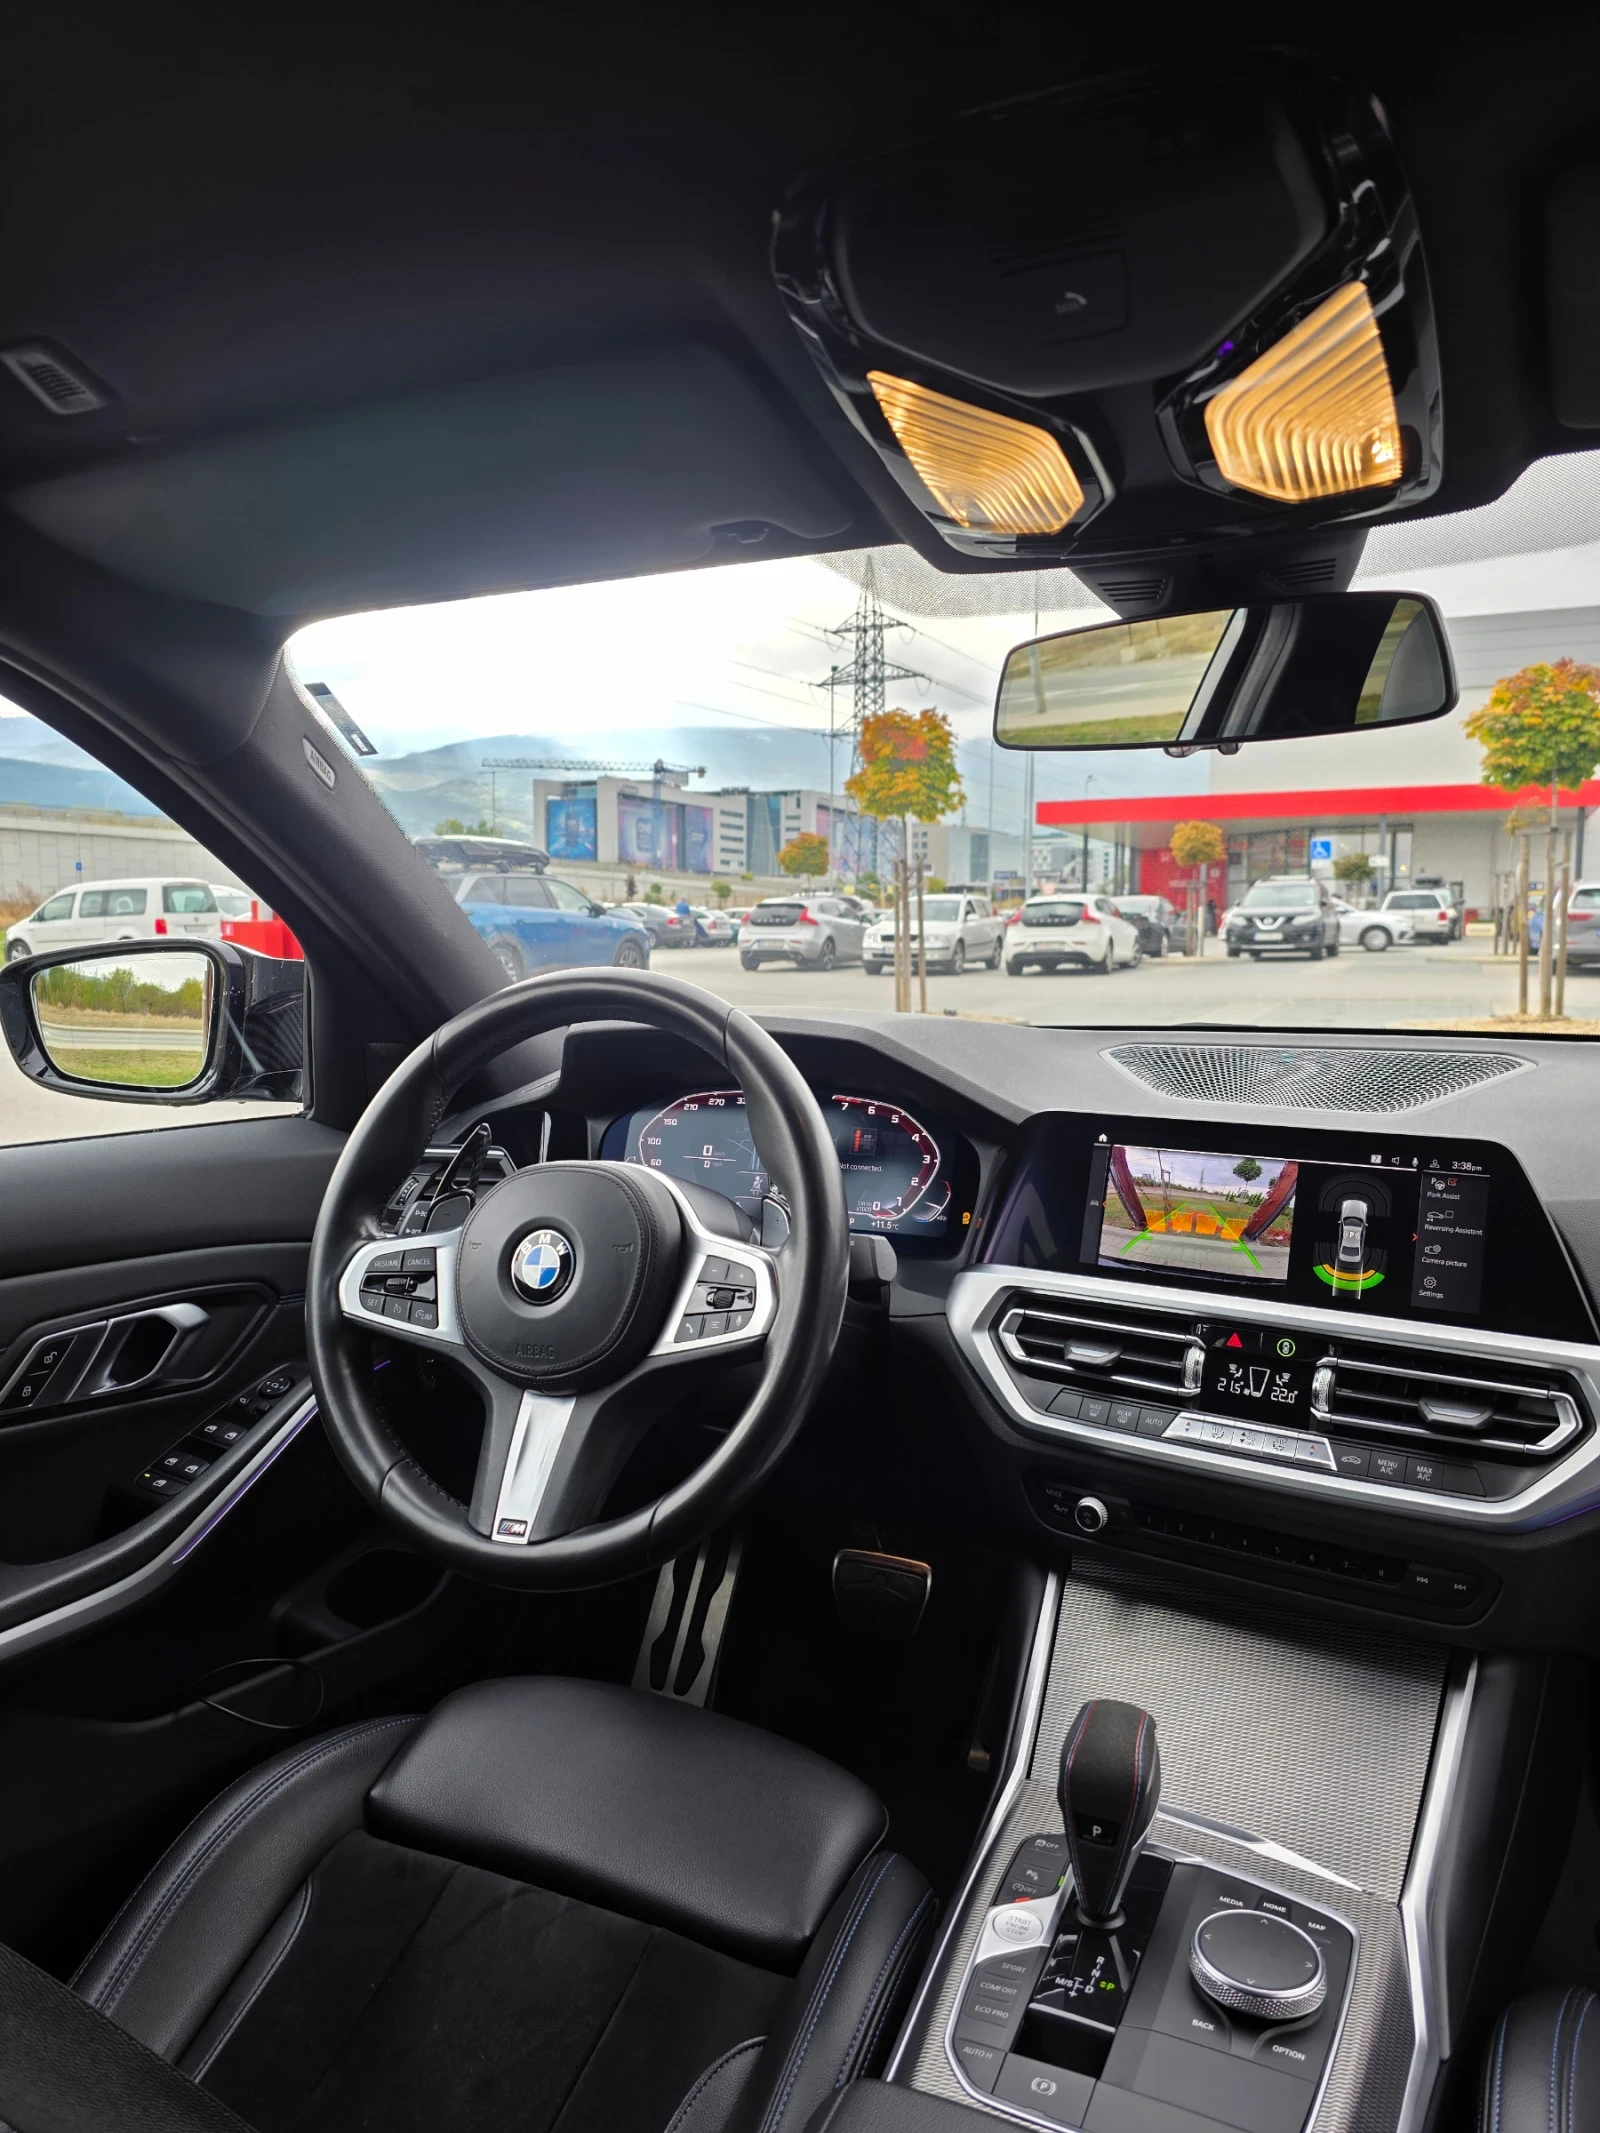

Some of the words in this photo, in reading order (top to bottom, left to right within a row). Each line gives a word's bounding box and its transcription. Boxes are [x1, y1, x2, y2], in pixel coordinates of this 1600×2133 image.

[684, 1103, 698, 1111] 210
[708, 1098, 725, 1106] 270
[841, 1102, 849, 1111] 7
[868, 1106, 876, 1115] 6
[891, 1115, 899, 1123] 5
[647, 1137, 661, 1145] 100
[911, 1133, 920, 1142] 4
[703, 1145, 713, 1156] 0
[703, 1160, 711, 1168] 0
[922, 1155, 931, 1164] 3
[1452, 1160, 1483, 1172] 3:38pm
[911, 1177, 919, 1186] 2
[1427, 1191, 1442, 1199] Park
[1442, 1192, 1461, 1200] Assist
[872, 1201, 881, 1211] 0
[896, 1196, 902, 1206] 1
[1424, 1224, 1454, 1233] Reversing
[1455, 1227, 1483, 1236] Assistant
[520, 1233, 569, 1256] BMW
[407, 1258, 431, 1266] CANCEL
[1421, 1257, 1445, 1265] Camera
[1446, 1260, 1468, 1268] picture
[1419, 1289, 1444, 1299] Settings
[366, 1299, 378, 1307] SET
[421, 1312, 433, 1321] LIM
[1117, 1409, 1133, 1417] REAR
[1145, 1417, 1163, 1426] AUTO
[1377, 1458, 1398, 1469] MENU
[1380, 1466, 1394, 1475] A/C
[1416, 1465, 1433, 1475] MAX
[1417, 1473, 1431, 1481] A/C
[1046, 1488, 1062, 1498] MODE
[1309, 1554, 1315, 1562] 6
[1378, 1569, 1384, 1577] 8
[1092, 1825, 1102, 1836] P
[1046, 1842, 1060, 1850] OFF
[1024, 1886, 1037, 1894] OFF
[1218, 1896, 1244, 1907] MEDIA
[1263, 1901, 1287, 1913] HOME
[1009, 1915, 1032, 1926] START
[1005, 1920, 1029, 1932] ENGINE
[1307, 1921, 1326, 1931] MAP
[1006, 1927, 1026, 1936] STOP
[1096, 1955, 1105, 1965] R
[1001, 1962, 1027, 1974] SPORT
[1091, 1968, 1101, 1978] N
[1055, 1976, 1074, 1988] M/S
[1106, 1982, 1115, 1991] P
[980, 1981, 1018, 1996] COMFORT
[1084, 1985, 1095, 1994] D
[974, 2004, 992, 2014] ECO
[992, 2009, 1009, 2019] PRO
[1191, 2018, 1215, 2031] BACK
[962, 2046, 985, 2058] AUTO
[985, 2052, 993, 2060] H
[1272, 2044, 1306, 2061] OPTION
